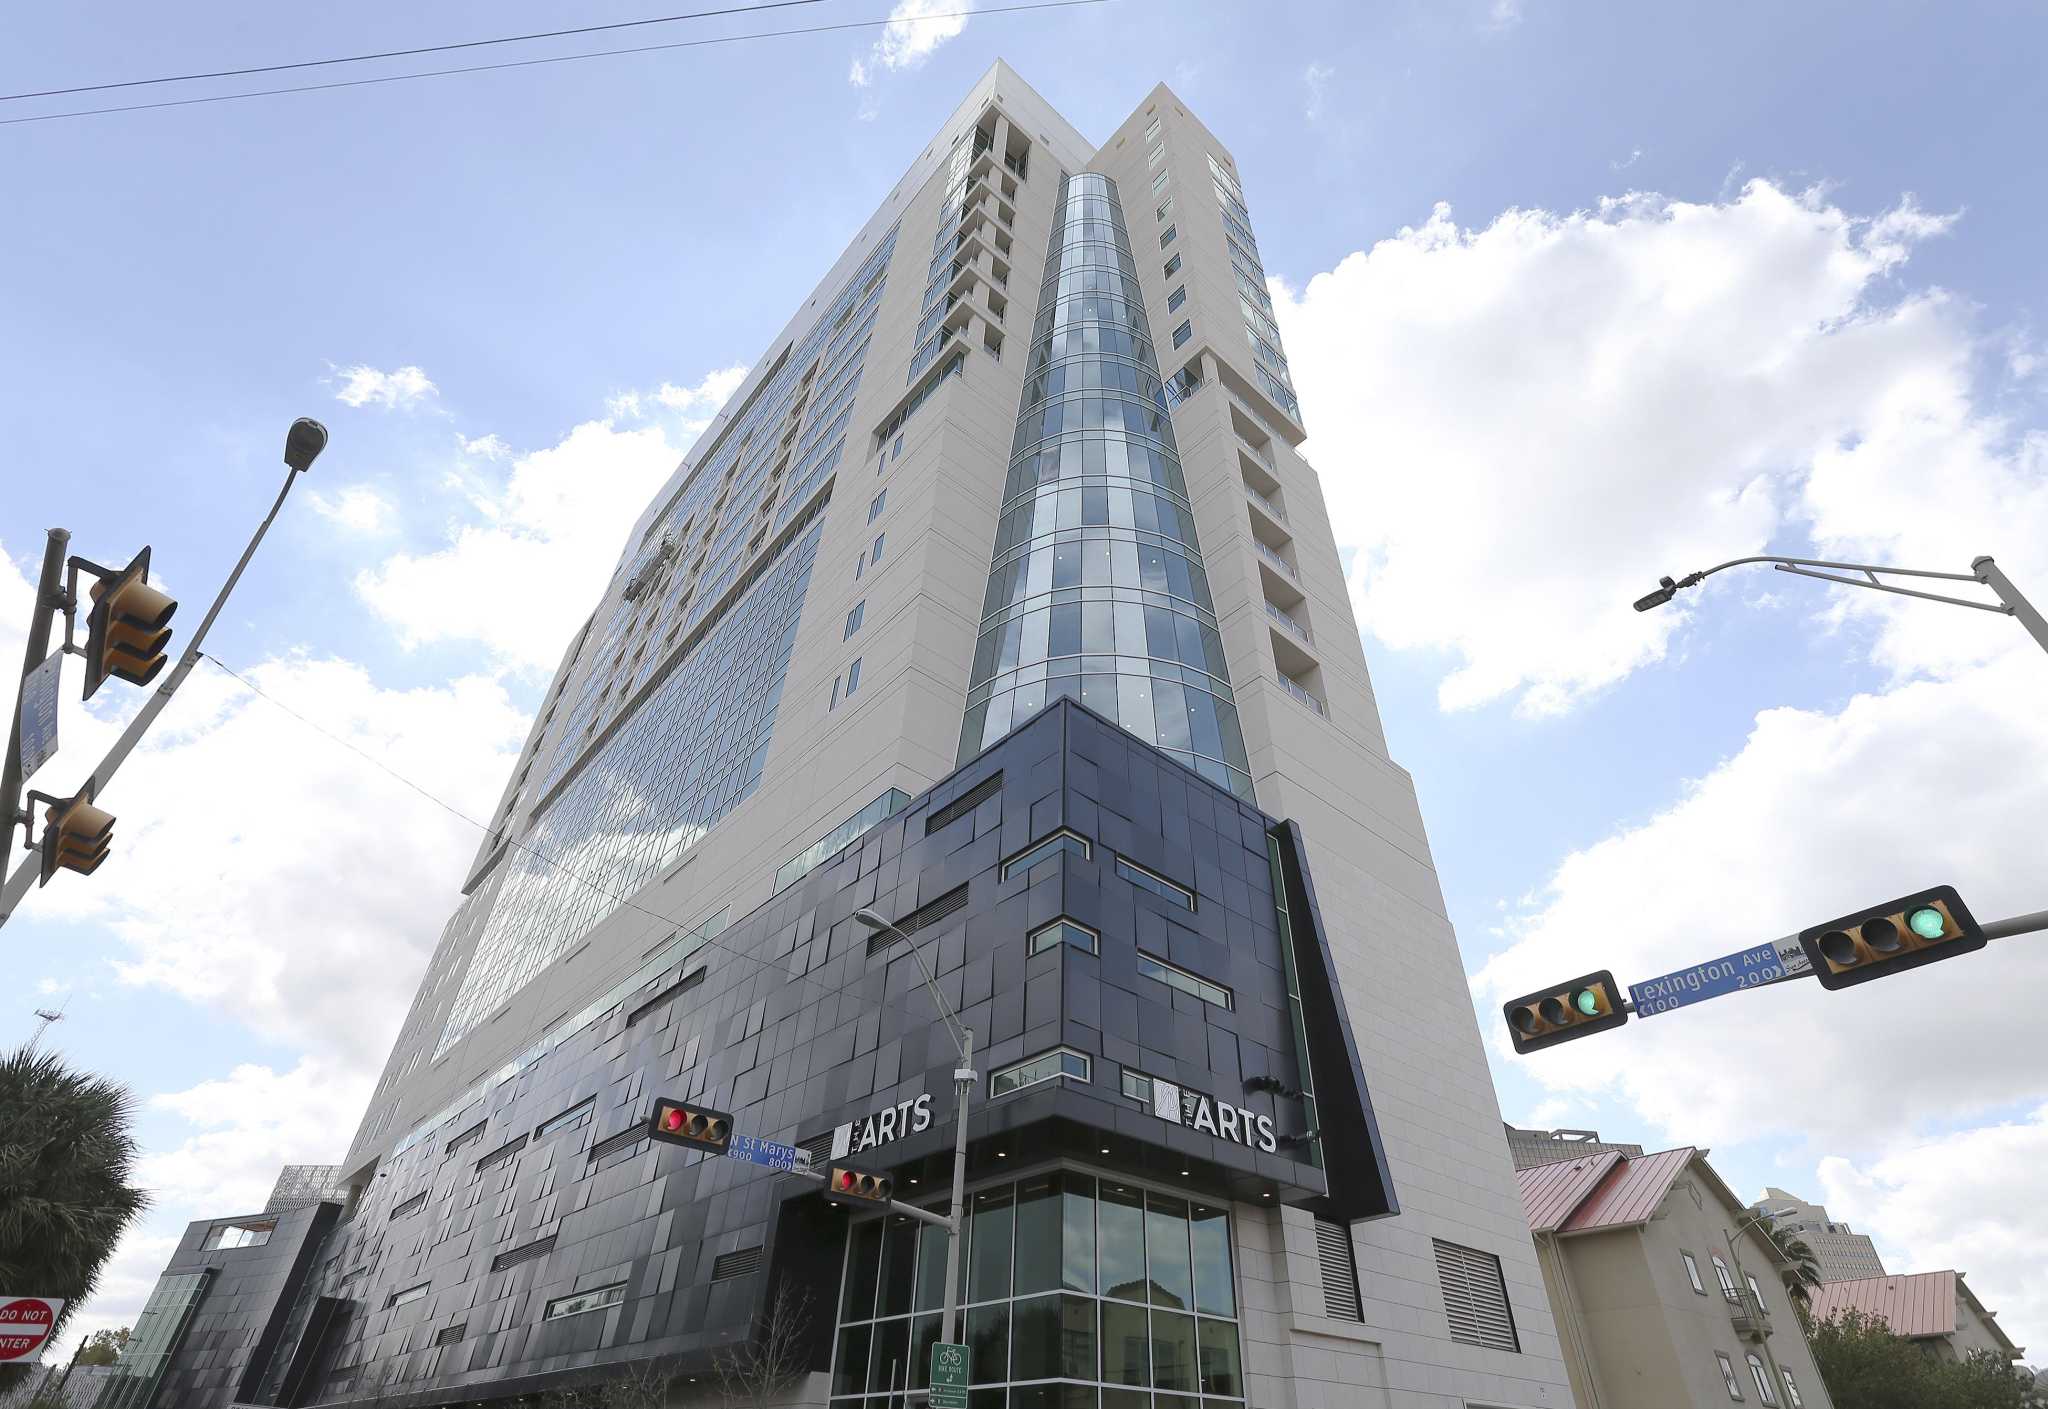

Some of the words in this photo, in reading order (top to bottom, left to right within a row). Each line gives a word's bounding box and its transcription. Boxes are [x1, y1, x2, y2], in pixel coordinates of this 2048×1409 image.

[1633, 960, 1735, 1002] Lexington
[1743, 949, 1772, 967] Ave
[1736, 967, 1773, 988] 200
[1647, 996, 1679, 1014] 100
[857, 1093, 931, 1153] ARTS
[1193, 1095, 1277, 1154] ARTS
[729, 1134, 739, 1147] N
[743, 1136, 755, 1150] St
[759, 1141, 794, 1161] Marys
[733, 1150, 752, 1161] 900
[768, 1157, 787, 1169] 800
[0, 1310, 17, 1320] DO
[21, 1310, 48, 1321] NOT
[0, 1337, 31, 1349] NTER
